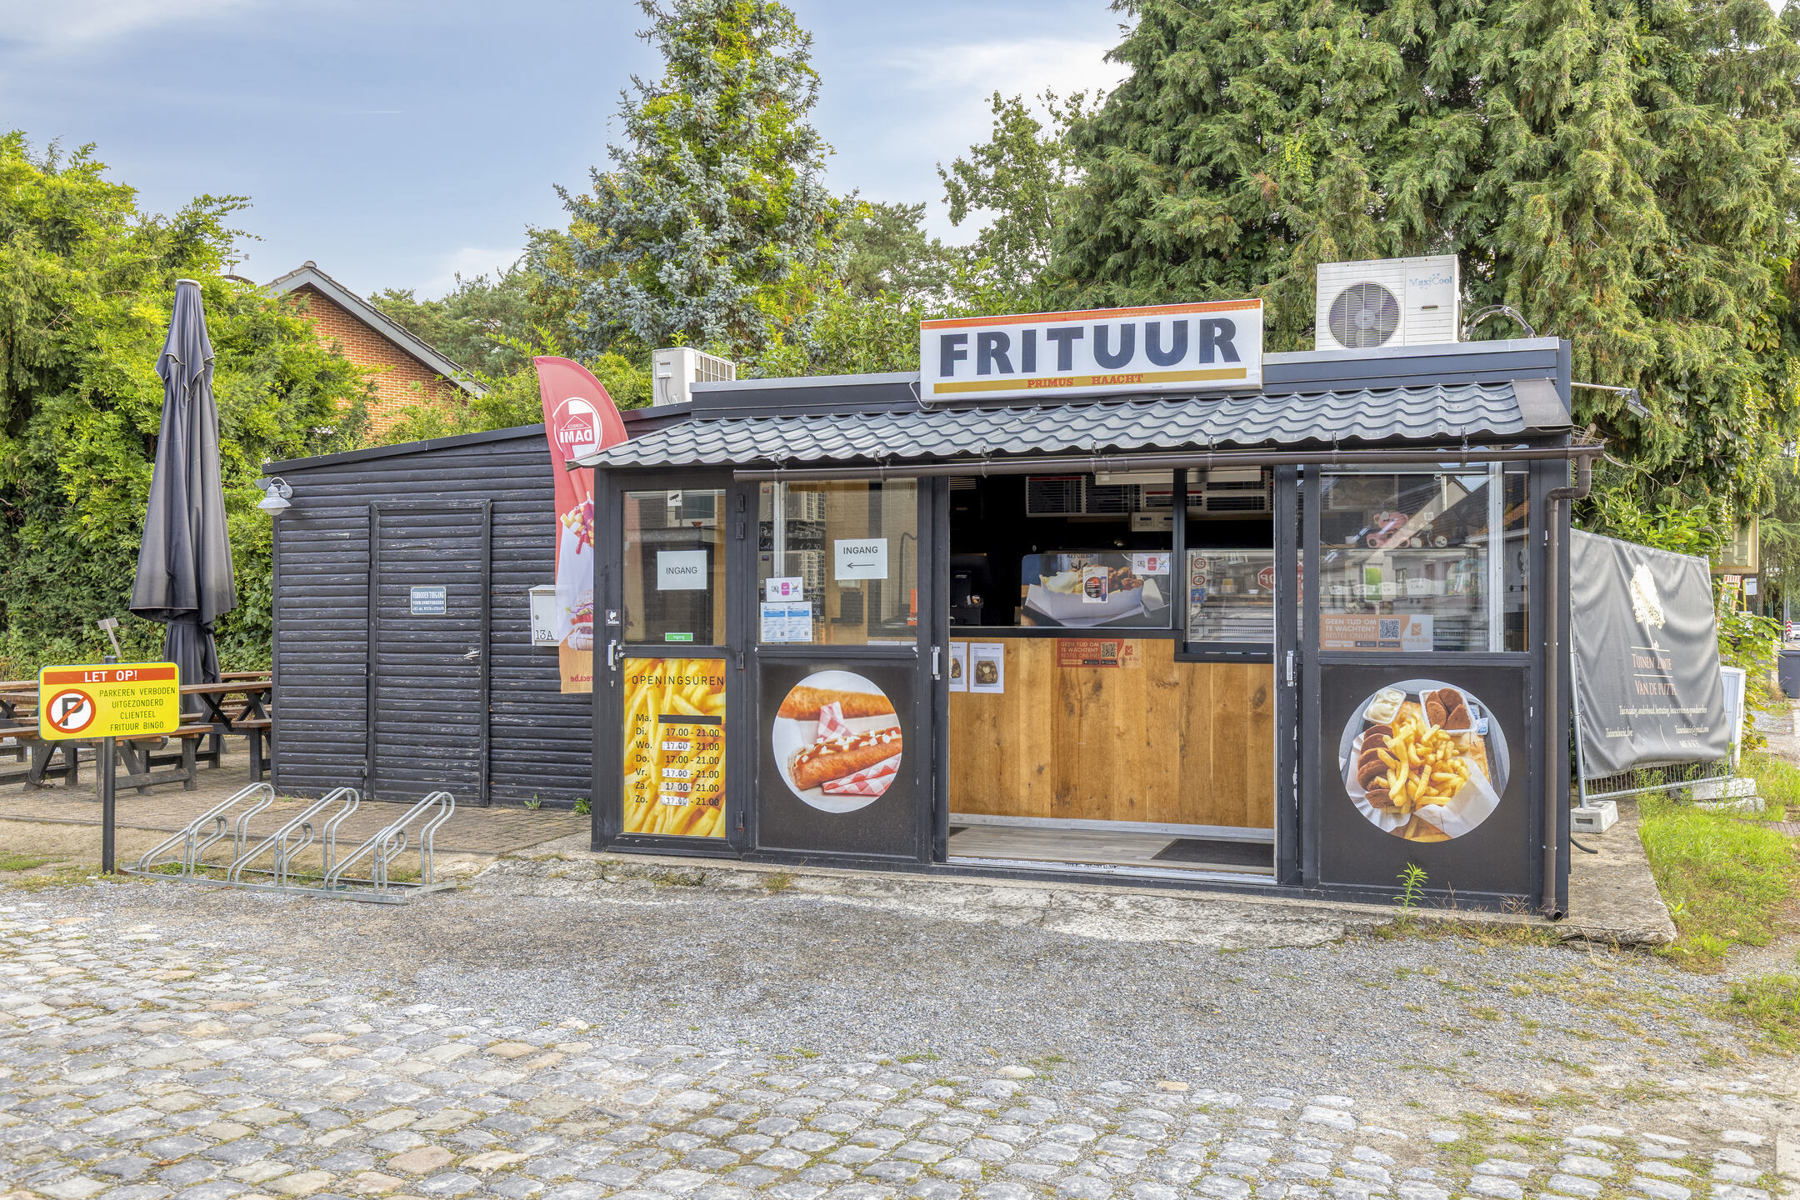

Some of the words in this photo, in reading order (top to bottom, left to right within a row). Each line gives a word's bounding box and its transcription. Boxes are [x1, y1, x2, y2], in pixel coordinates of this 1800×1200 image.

[939, 317, 1241, 377] FRITUUR
[1027, 377, 1074, 389] PRIMUS
[1091, 373, 1144, 386] HAACHT
[843, 546, 879, 555] INGANG
[665, 566, 698, 575] INGANG
[536, 629, 554, 641] 13A
[84, 671, 108, 683] LET
[116, 670, 138, 681] OP!
[631, 675, 724, 686] OPENINGSUREN
[100, 688, 136, 697] PARKEREN
[140, 686, 176, 695] VERBODEN
[111, 698, 164, 709] UITGEZONDERD
[120, 711, 156, 720] CLIENTEEL
[635, 713, 652, 722] Ma.
[110, 722, 139, 731] FRITUUR
[143, 721, 164, 730] BINGO
[635, 727, 647, 735] Di.
[666, 728, 689, 736] 17.00
[696, 728, 720, 737] 21.00
[635, 741, 652, 749] Wo.
[666, 742, 688, 750] 17.00
[696, 742, 720, 751] 21.00
[635, 754, 650, 763] Do.
[666, 755, 689, 763] 17.00
[696, 756, 720, 765] 21.00
[635, 768, 648, 776] Vr.
[666, 769, 688, 777] 17.00
[696, 770, 720, 779] 21.00
[635, 781, 648, 790] Za.
[696, 784, 720, 792] 21.00
[635, 795, 648, 803] Zo.
[696, 797, 720, 806] 21.00
